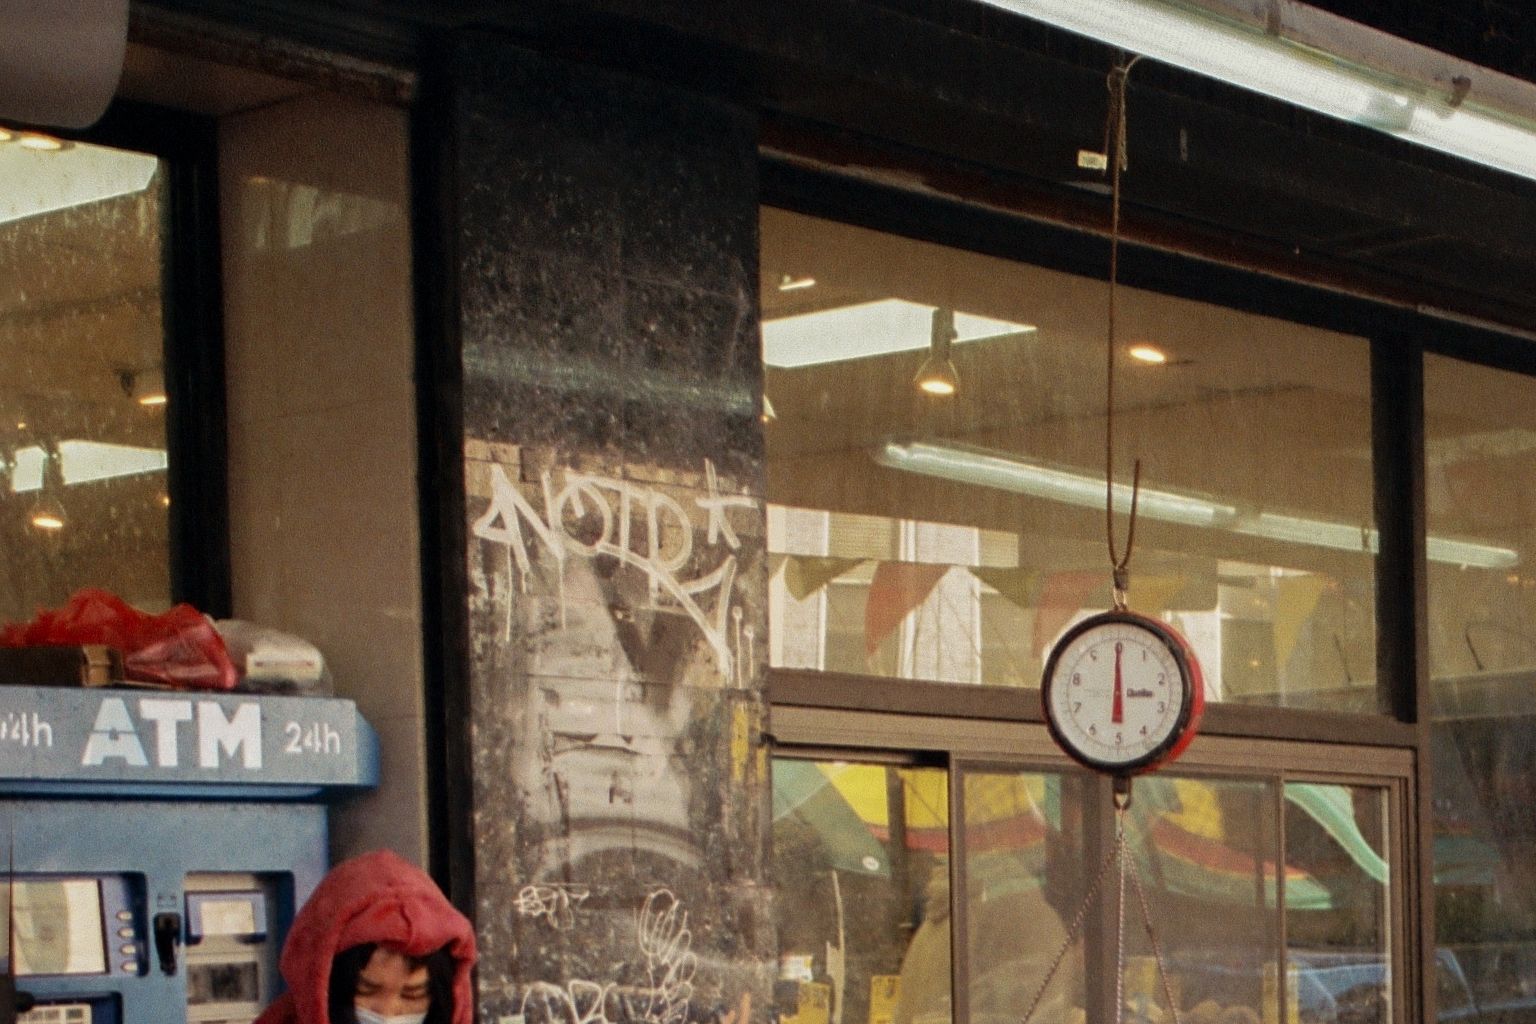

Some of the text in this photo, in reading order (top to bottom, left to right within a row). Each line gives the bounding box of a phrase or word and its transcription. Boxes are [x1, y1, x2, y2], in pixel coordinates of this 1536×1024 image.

[1142, 650, 1147, 661] 1
[1072, 674, 1080, 686] 8
[1158, 673, 1165, 685] 2
[1074, 702, 1082, 713] 7
[1157, 702, 1165, 713] 3
[0, 698, 341, 768] 4h ATM 24h
[1088, 726, 1096, 736] 6
[1139, 725, 1147, 735] 4
[1115, 732, 1123, 744] 5
